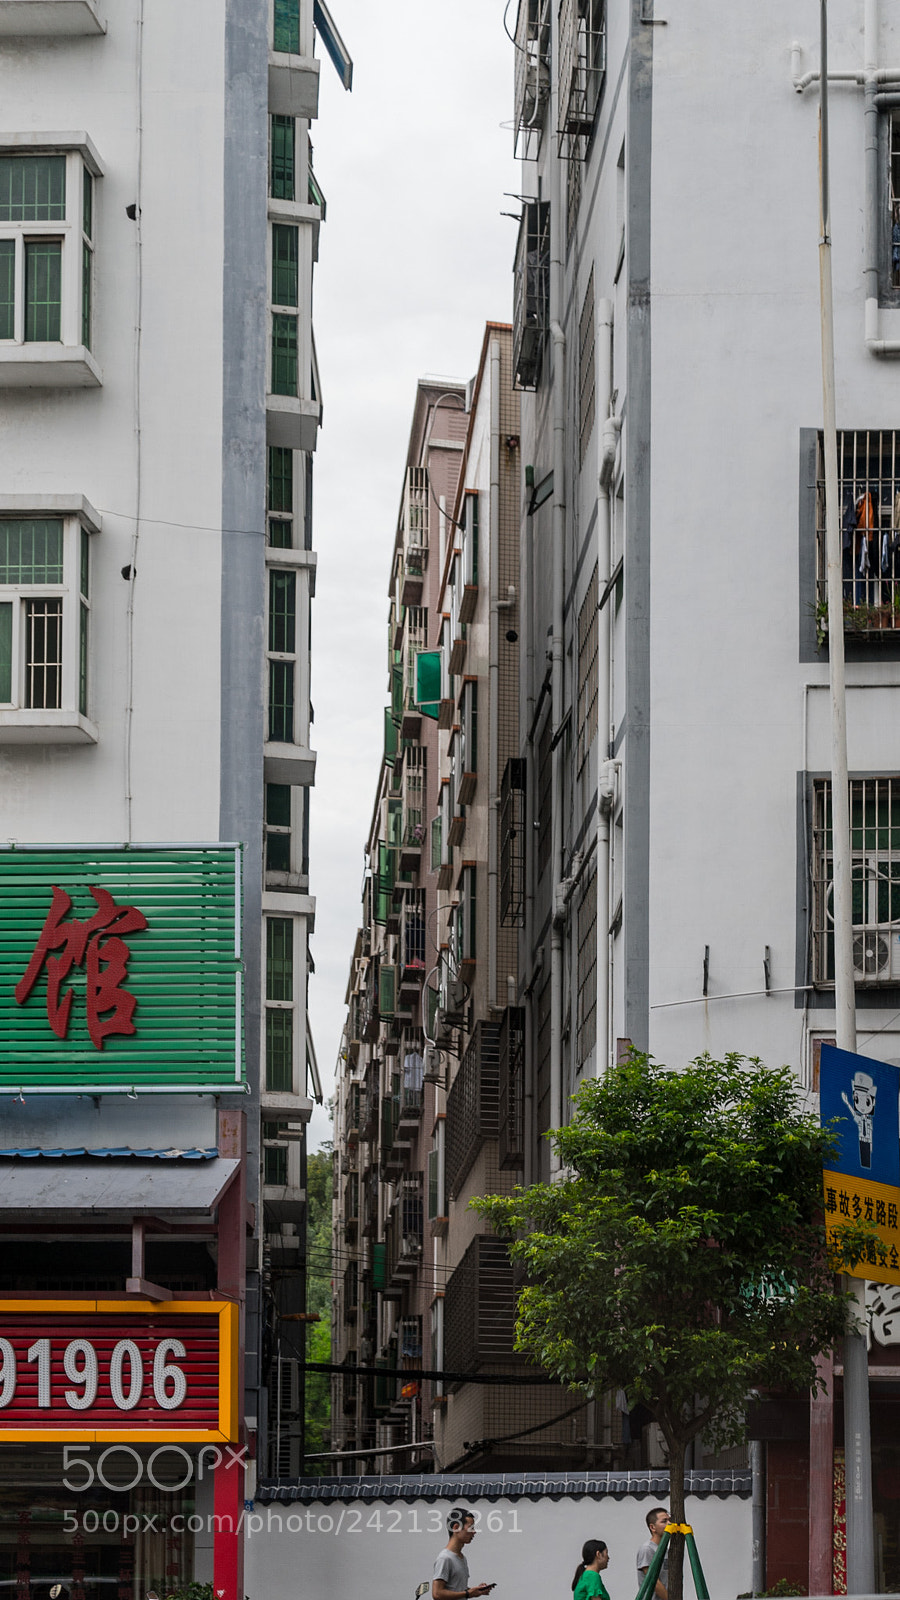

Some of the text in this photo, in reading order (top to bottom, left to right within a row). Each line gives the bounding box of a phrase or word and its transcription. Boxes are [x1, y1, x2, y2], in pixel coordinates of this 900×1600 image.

[14, 885, 149, 1051] 馆
[825, 1187, 898, 1230] 事故多发路段
